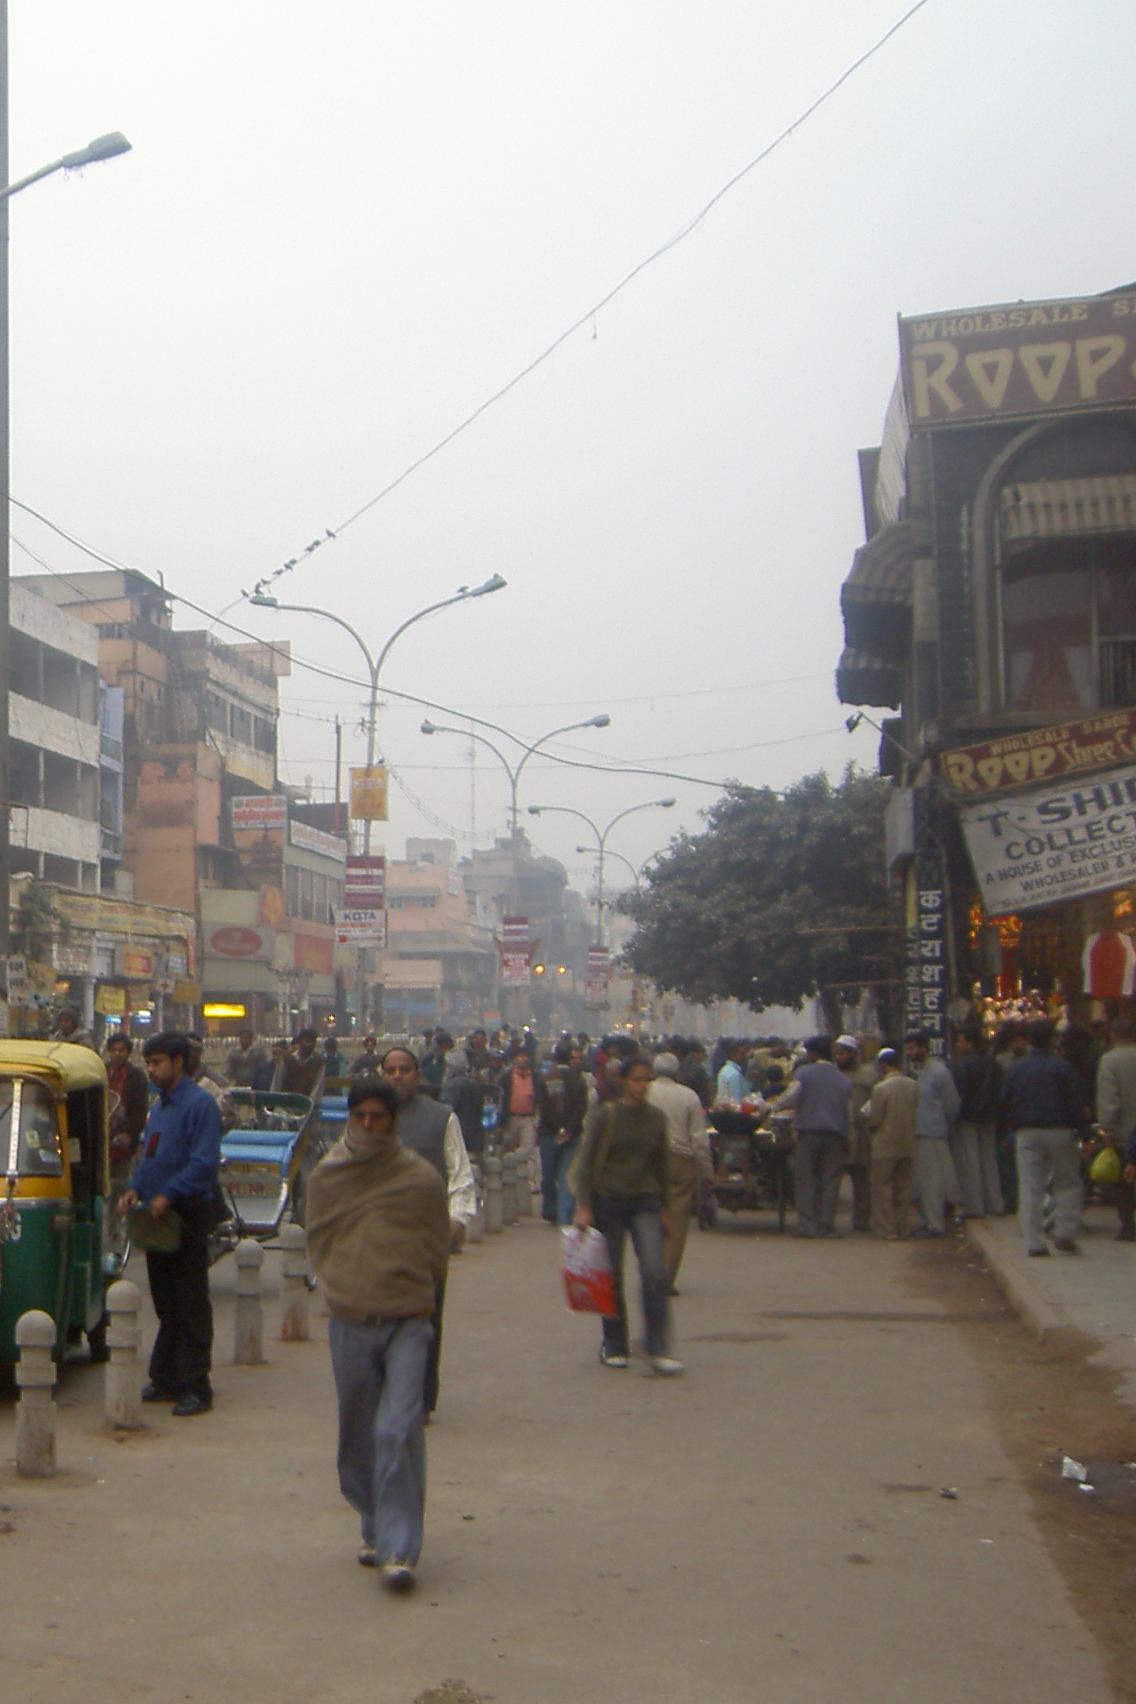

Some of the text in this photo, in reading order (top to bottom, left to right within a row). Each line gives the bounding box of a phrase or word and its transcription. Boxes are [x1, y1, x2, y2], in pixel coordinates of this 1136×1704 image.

[914, 303, 1089, 340] WHOLESALE
[912, 334, 1127, 418] ROOP
[946, 745, 1057, 791] ROOP
[985, 872, 996, 885] A
[997, 859, 1044, 881] HOUSE
[1046, 854, 1064, 869] OF
[1021, 860, 1111, 892] WHOLESALER
[343, 911, 377, 922] KOTA
